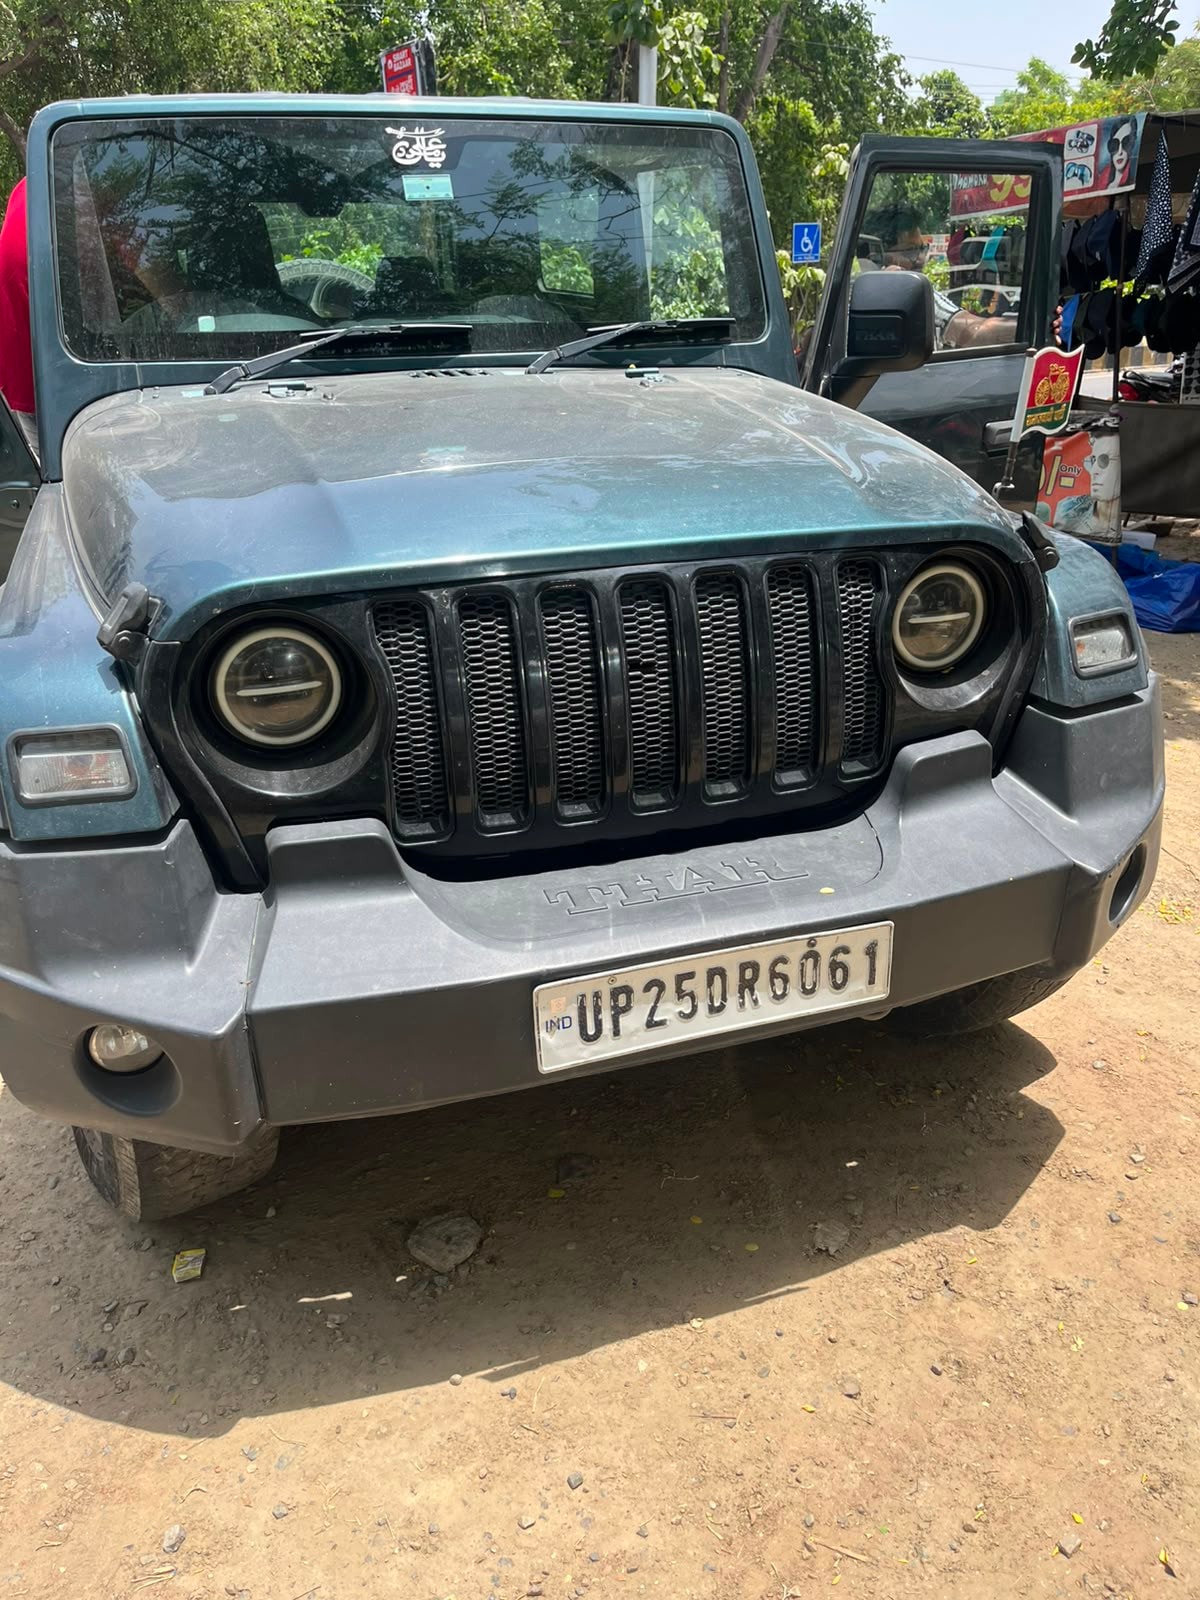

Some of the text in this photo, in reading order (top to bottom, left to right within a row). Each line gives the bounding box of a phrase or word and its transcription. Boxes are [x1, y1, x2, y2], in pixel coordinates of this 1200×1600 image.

[393, 58, 412, 72] BAZAAR
[1060, 465, 1081, 476] Only
[543, 857, 809, 916] THAR
[576, 939, 880, 1045] UP25DR6061
[545, 1016, 572, 1033] IND
